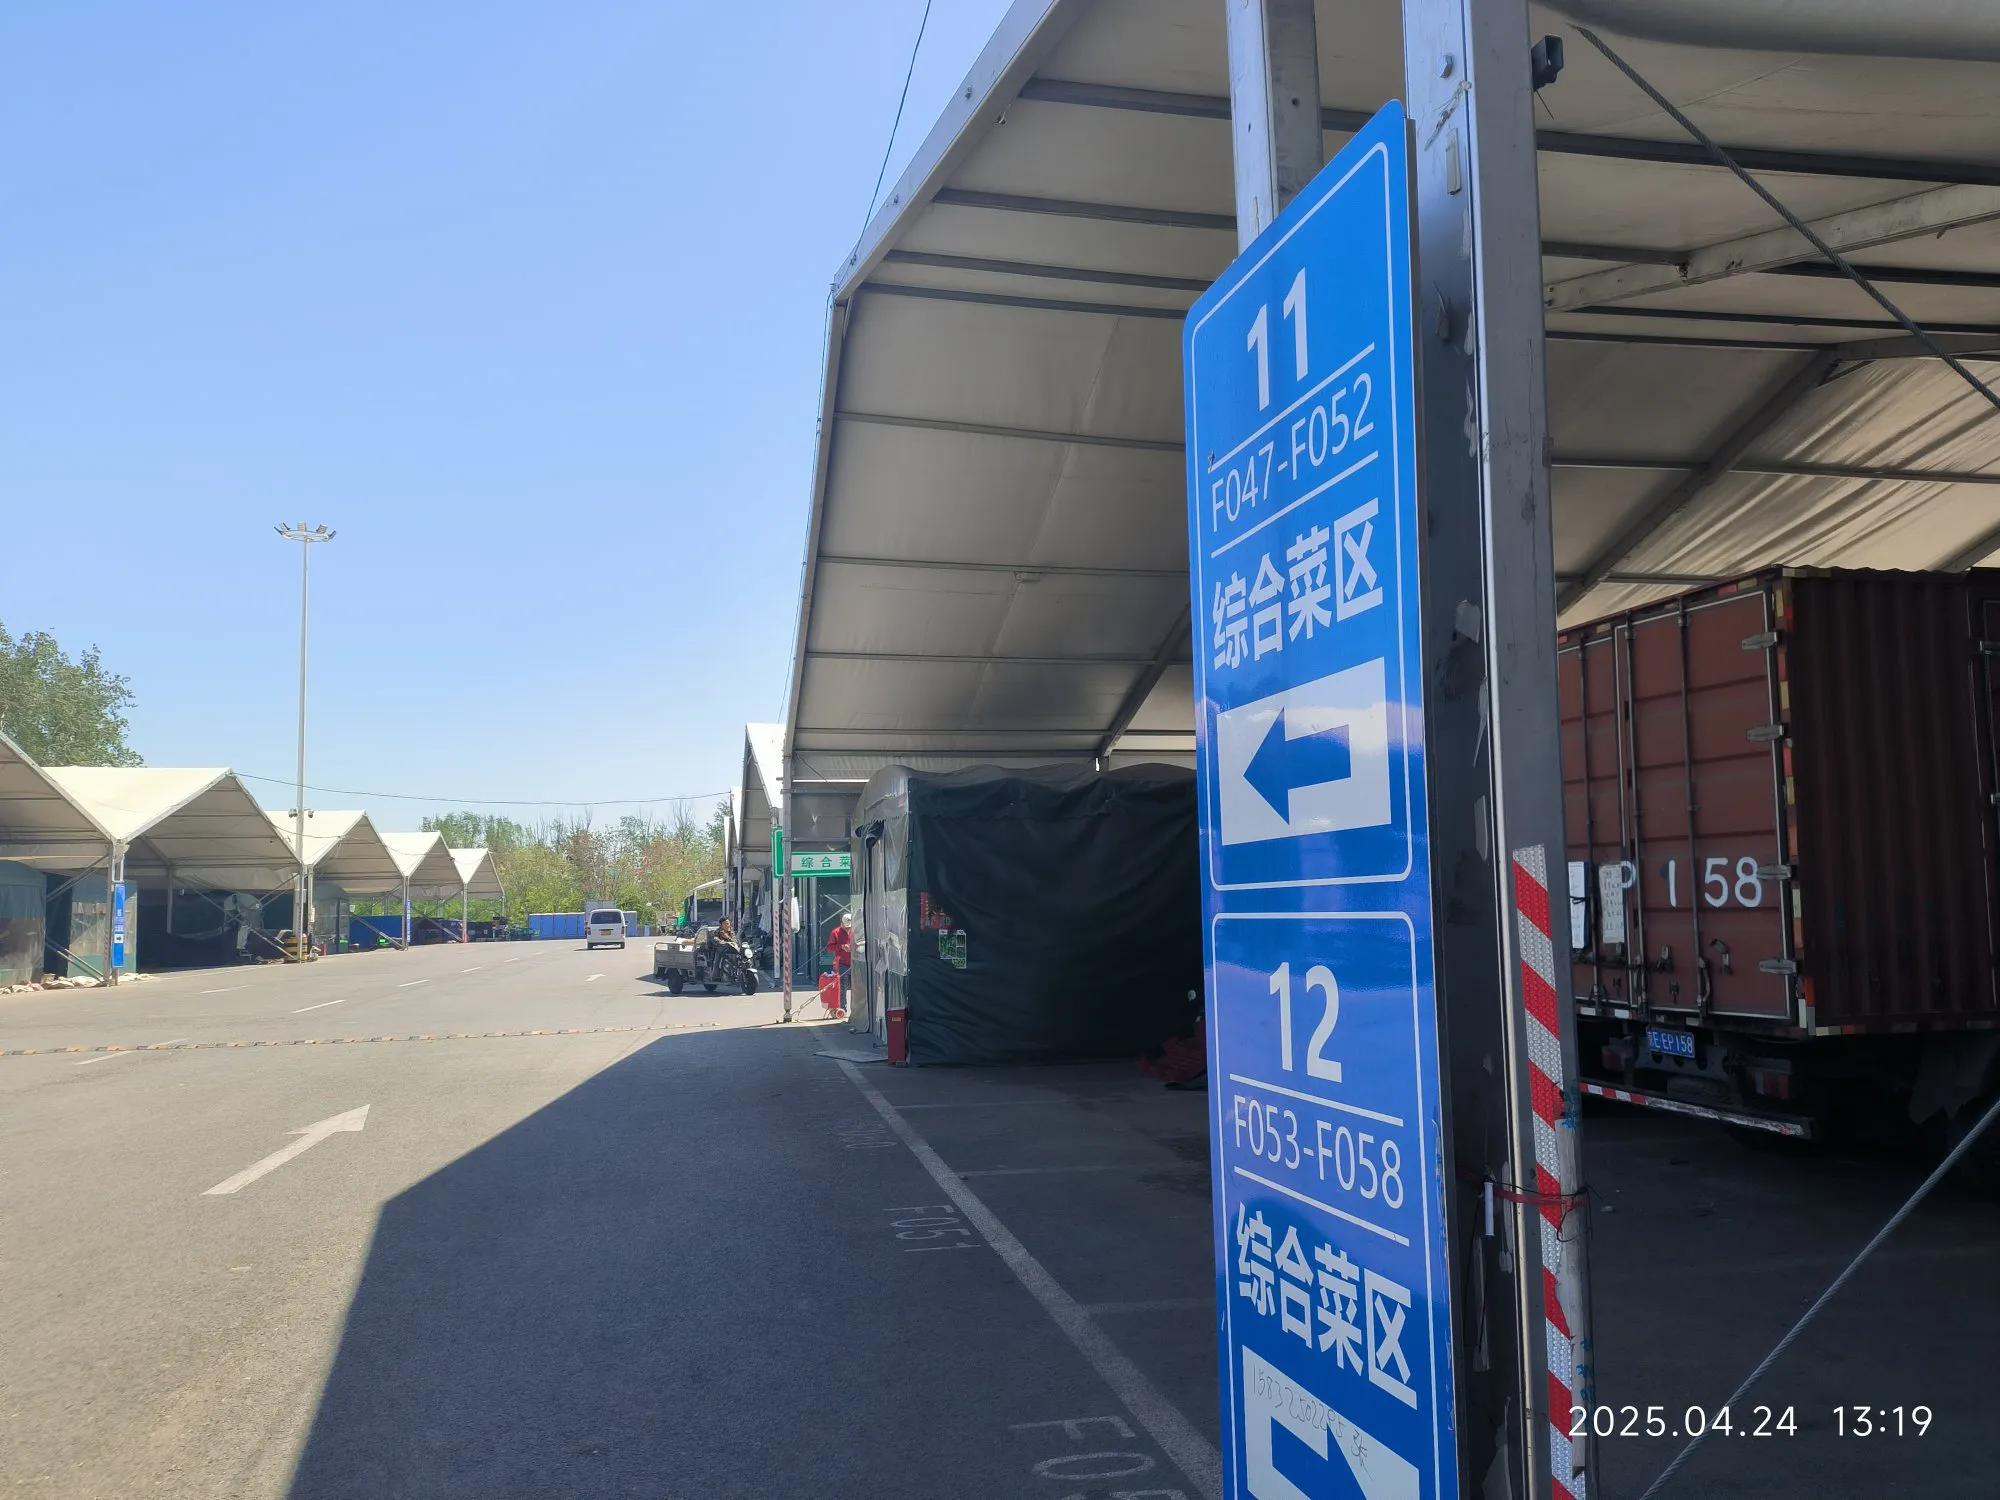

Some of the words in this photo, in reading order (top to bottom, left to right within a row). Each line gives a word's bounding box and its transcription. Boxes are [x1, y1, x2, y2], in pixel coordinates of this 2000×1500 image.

[1247, 266, 1308, 412] 11
[1212, 372, 1374, 532] F047-F052
[1212, 498, 1383, 670] 综合菜区
[1269, 962, 1342, 1083] 12
[1233, 1094, 1404, 1209] F053-F058
[1236, 1200, 1418, 1411] 综合菜区
